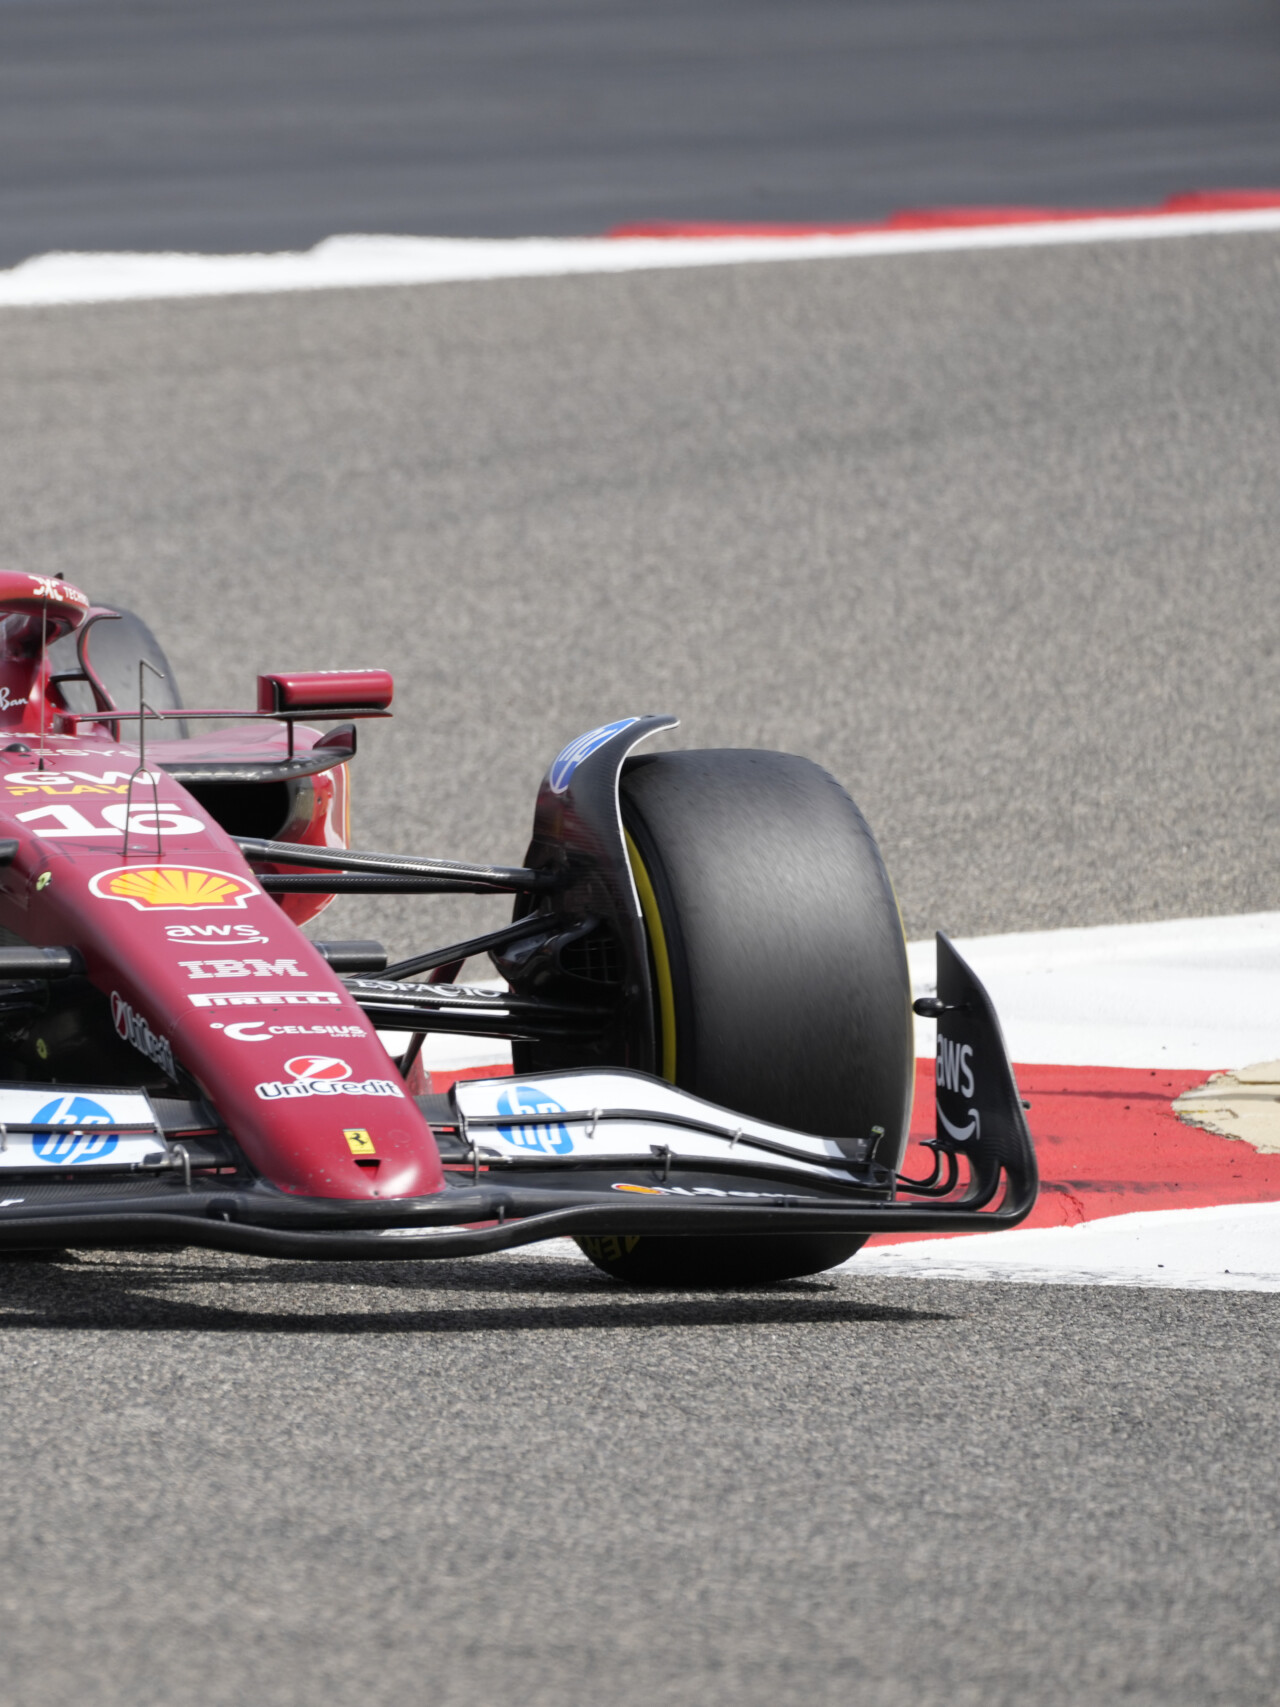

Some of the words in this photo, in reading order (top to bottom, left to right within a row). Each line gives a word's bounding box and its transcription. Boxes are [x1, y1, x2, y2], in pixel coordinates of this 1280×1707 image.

[5, 784, 130, 796] PLAY
[15, 803, 206, 838] 16
[165, 925, 261, 937] aws
[177, 959, 309, 979] IBM
[187, 992, 342, 1007] PIRELLI
[268, 1025, 368, 1035] CELSIUS
[937, 1033, 974, 1098] aws
[256, 1080, 405, 1100] UniCredit
[39, 1096, 111, 1165] hp
[507, 1086, 563, 1155] hp
